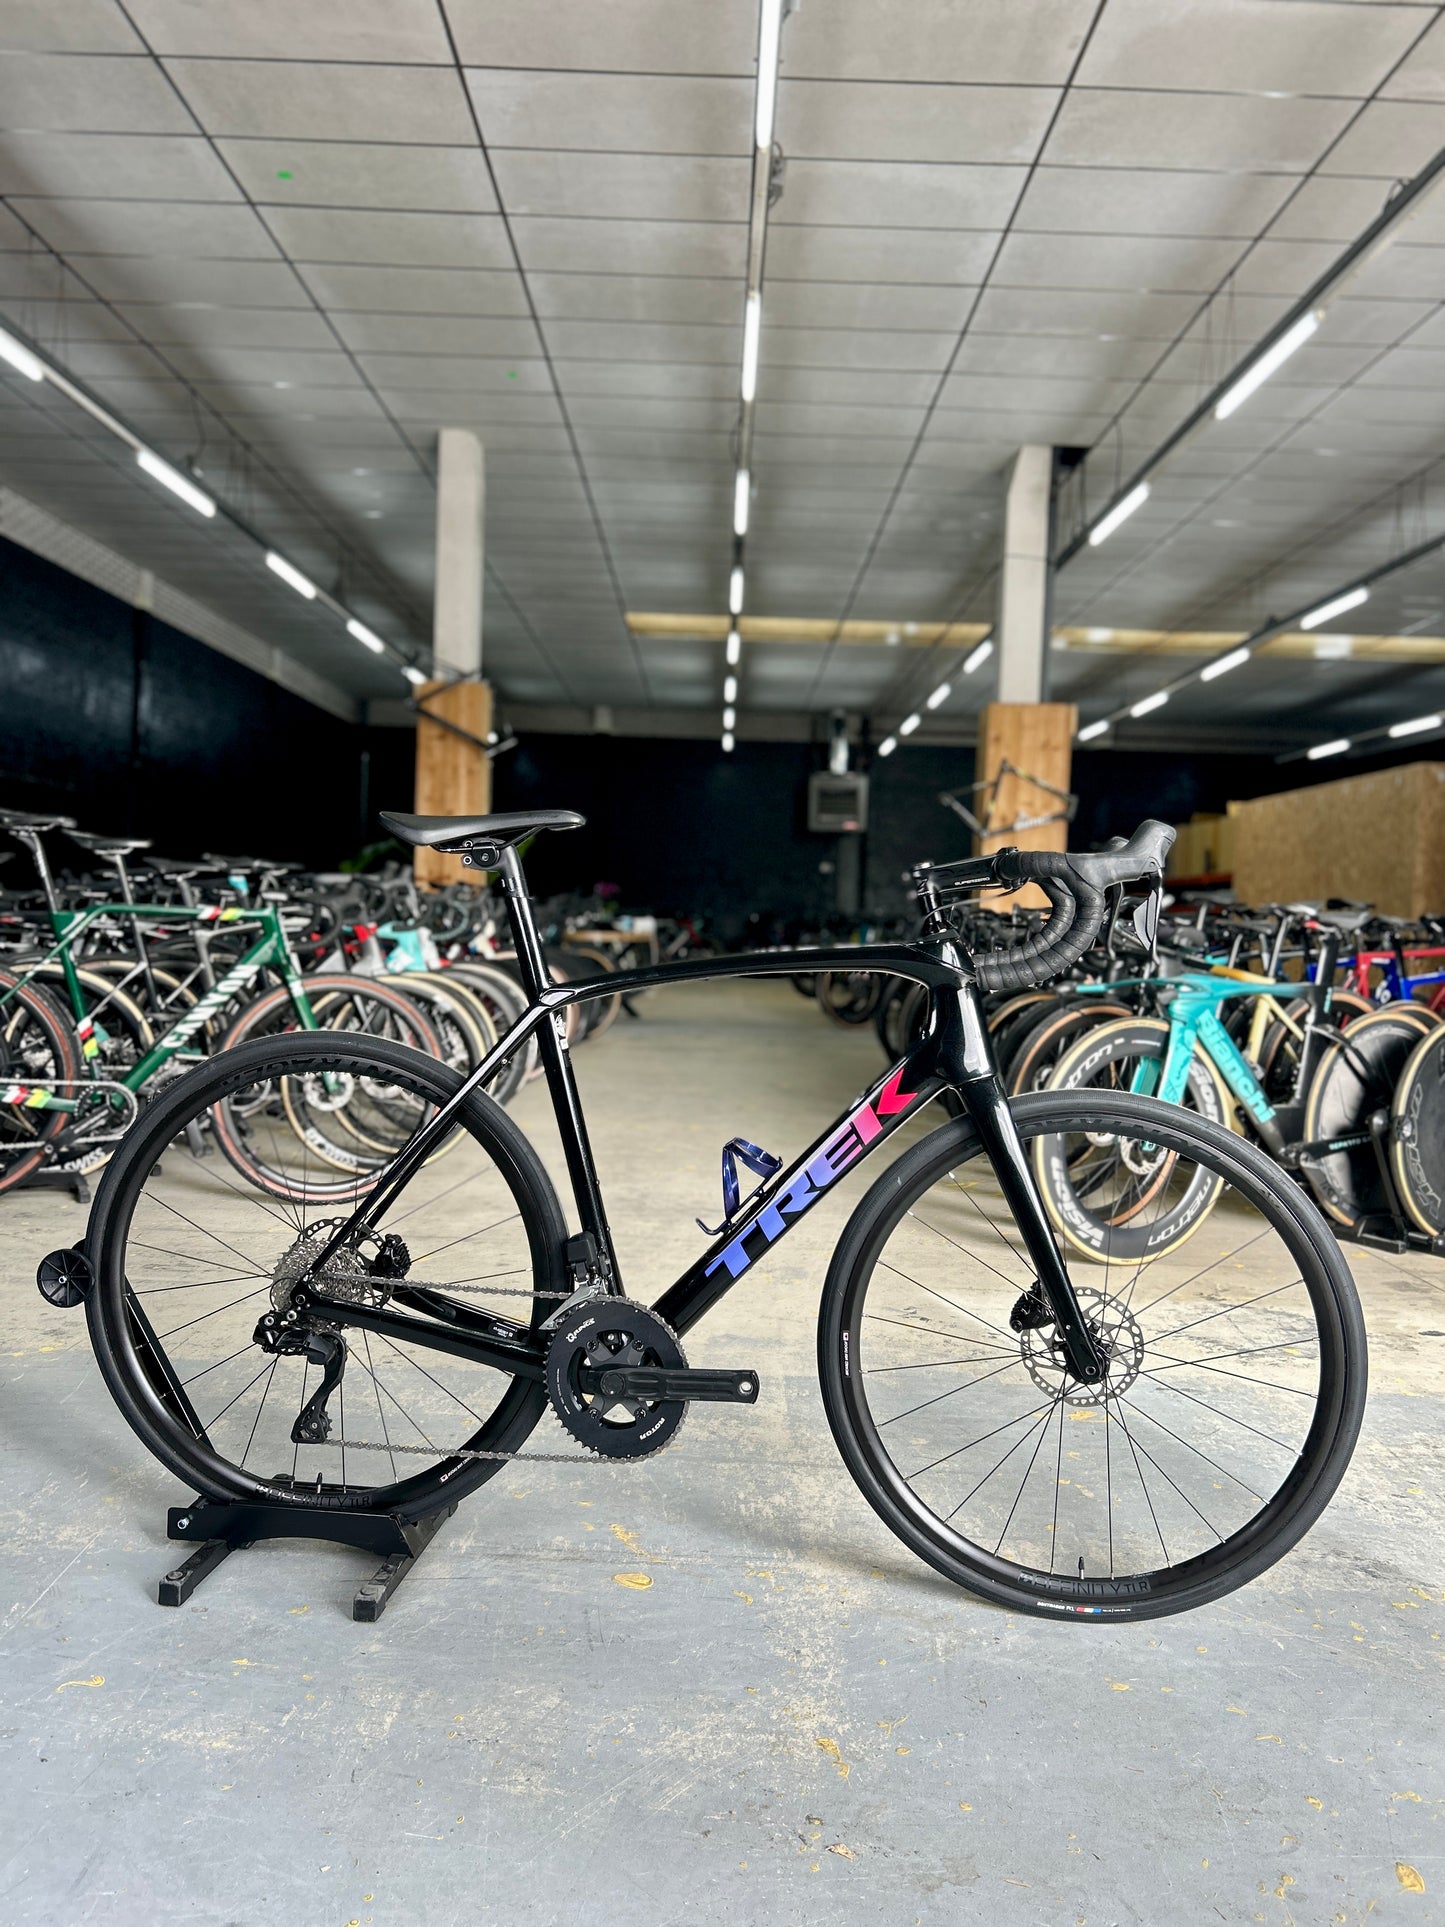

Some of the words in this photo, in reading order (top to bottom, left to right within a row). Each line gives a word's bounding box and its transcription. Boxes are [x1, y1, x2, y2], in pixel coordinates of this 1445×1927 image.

[161, 964, 261, 1048] CANYON
[1065, 1043, 1113, 1089] tron
[1196, 1008, 1277, 1124] Bianchi
[64, 1146, 106, 1171] SWISS
[705, 1069, 918, 1279] TREK
[639, 1417, 666, 1441] ROTOR
[1123, 1580, 1149, 1594] TLR
